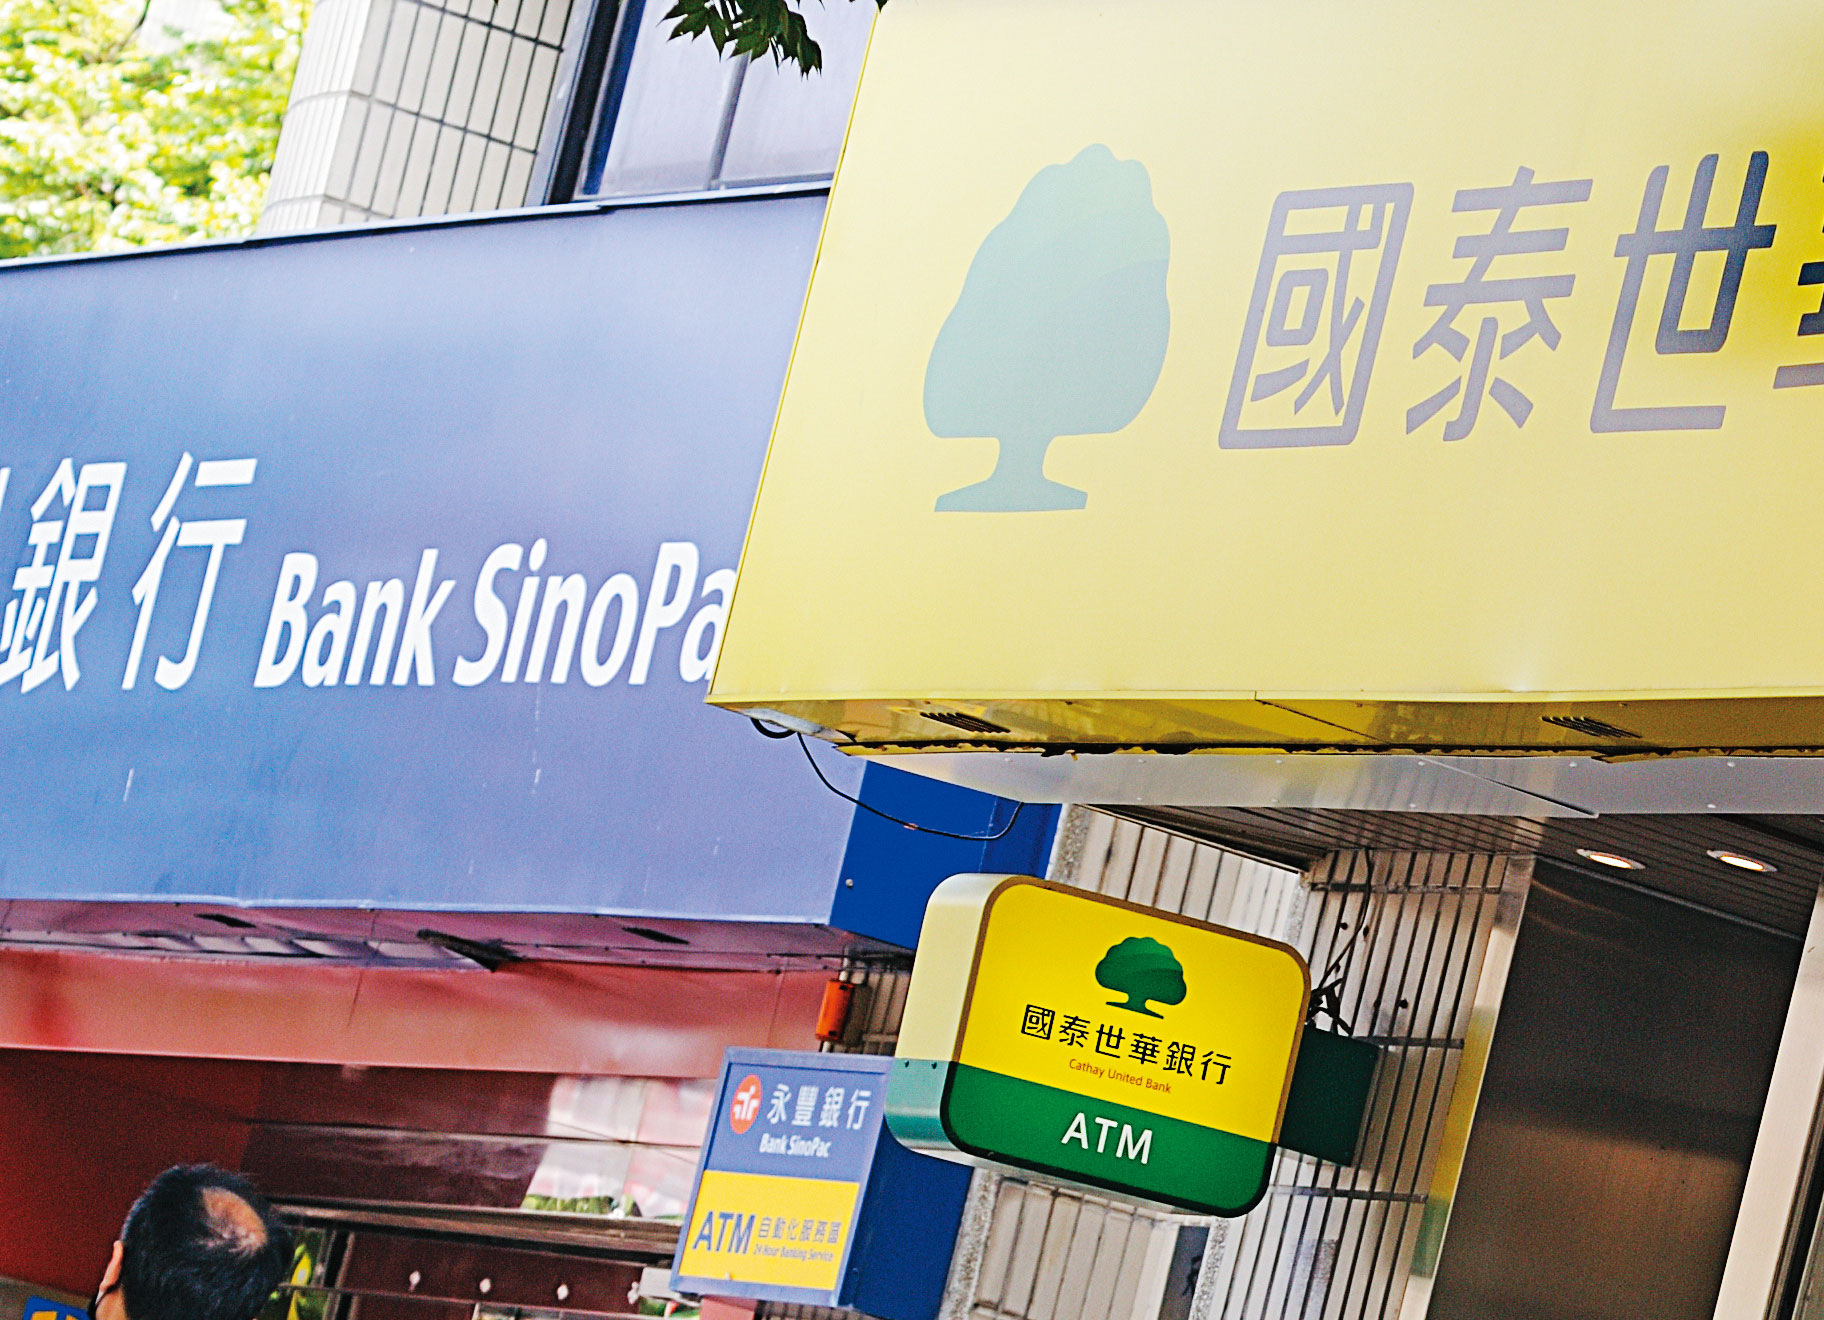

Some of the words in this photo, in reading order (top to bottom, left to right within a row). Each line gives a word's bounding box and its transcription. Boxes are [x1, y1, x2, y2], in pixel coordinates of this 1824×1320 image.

[0, 450, 258, 694] 銀行
[254, 548, 457, 688] Bank
[1021, 1004, 1233, 1085] 國泰世華銀行
[1069, 1057, 1105, 1079] Cathay
[1108, 1068, 1143, 1086] United
[1145, 1078, 1172, 1094] Bank
[766, 1083, 872, 1130] 永豐銀行
[759, 1133, 788, 1156] Bank
[787, 1135, 832, 1158] SinoPac
[1061, 1112, 1153, 1165] ATM
[692, 1210, 756, 1255] ATM
[808, 1248, 834, 1262] Service
